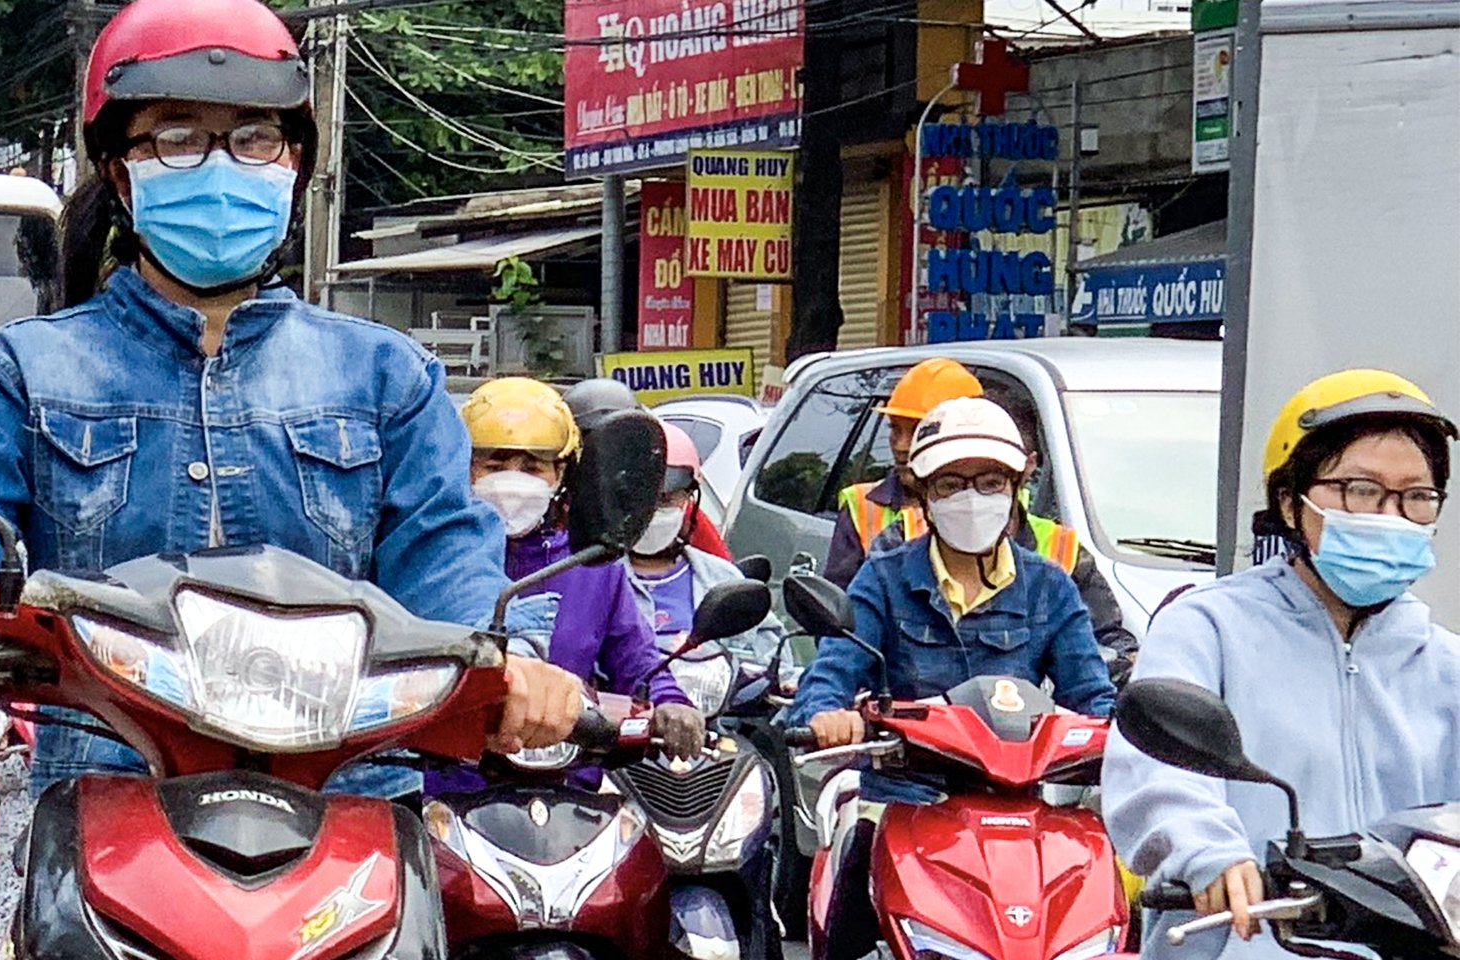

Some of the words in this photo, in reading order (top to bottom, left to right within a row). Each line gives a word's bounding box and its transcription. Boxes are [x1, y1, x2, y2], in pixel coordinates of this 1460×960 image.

[693, 156, 748, 176] QUANG
[755, 158, 789, 176] HUY
[691, 187, 738, 222] MUA
[745, 184, 789, 223] BÁN
[929, 165, 1057, 234] QUỐC
[689, 237, 710, 271] XE
[716, 234, 757, 272] MÁY
[764, 235, 789, 273] CŨ
[928, 238, 1054, 296] HÙNG
[1152, 267, 1197, 317] QUỐC
[699, 361, 745, 388] HUY
[198, 789, 298, 815] HONDA
[981, 816, 1032, 827] HONDA
